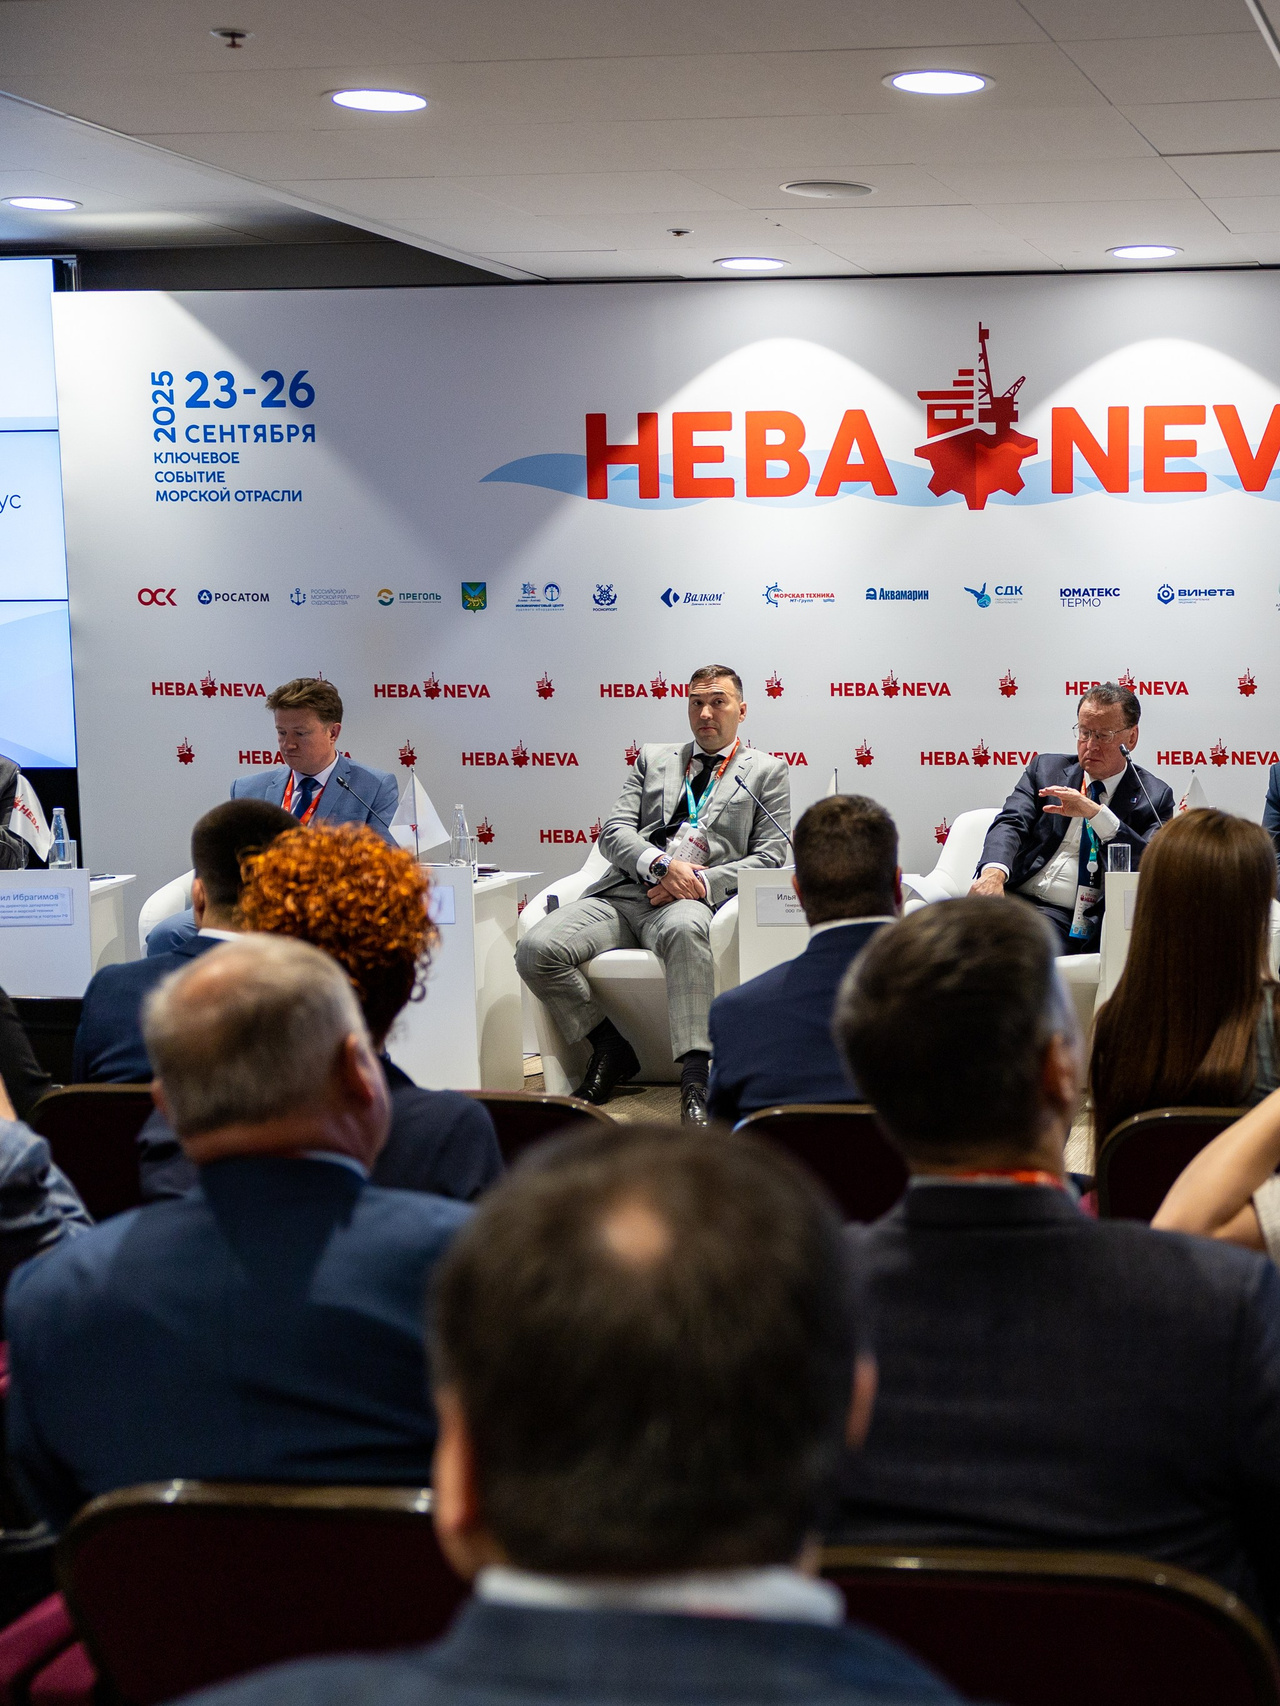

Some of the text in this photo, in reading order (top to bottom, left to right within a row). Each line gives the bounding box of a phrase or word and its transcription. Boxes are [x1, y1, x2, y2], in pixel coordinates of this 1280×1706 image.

[185, 370, 316, 409] 23-26
[151, 371, 176, 443] 2025
[185, 424, 316, 443] СЕНТЯБРЯ
[153, 452, 240, 464] КЛЮЧЕВОЕ
[585, 409, 898, 499] НЕВА
[154, 471, 226, 483] СОБЫТИЕ
[155, 487, 303, 502] МОРСКОЙ ОТРАСЛИ
[137, 588, 178, 606] ОСК
[214, 592, 270, 602] РОСАТОМ
[399, 592, 442, 601] ПРЕГОЛЬ
[683, 592, 722, 603] Валком
[879, 587, 929, 601] Аквамарин
[995, 585, 1023, 596] СДК
[1060, 588, 1120, 597] ЮМАТЕКС
[1060, 598, 1102, 607] ТЕРМО
[151, 682, 199, 696] НЕВА
[220, 683, 267, 697] NEVA
[374, 684, 422, 698] НЕВА
[443, 684, 491, 698] NEVA
[600, 684, 648, 697] НЕВА
[830, 683, 879, 697] НЕВА
[903, 683, 951, 697] NEVA
[1140, 681, 1189, 695] NEVA
[238, 751, 286, 765] НЕВА
[461, 752, 509, 766] НЕВА
[532, 752, 579, 766] NEVA
[768, 752, 808, 766] VA
[920, 752, 970, 766] НЕВА
[1157, 751, 1207, 765] НЕВА
[1232, 751, 1280, 765] NEVA
[540, 829, 588, 843] НЕВА
[12, 893, 59, 902] Ибрагимов
